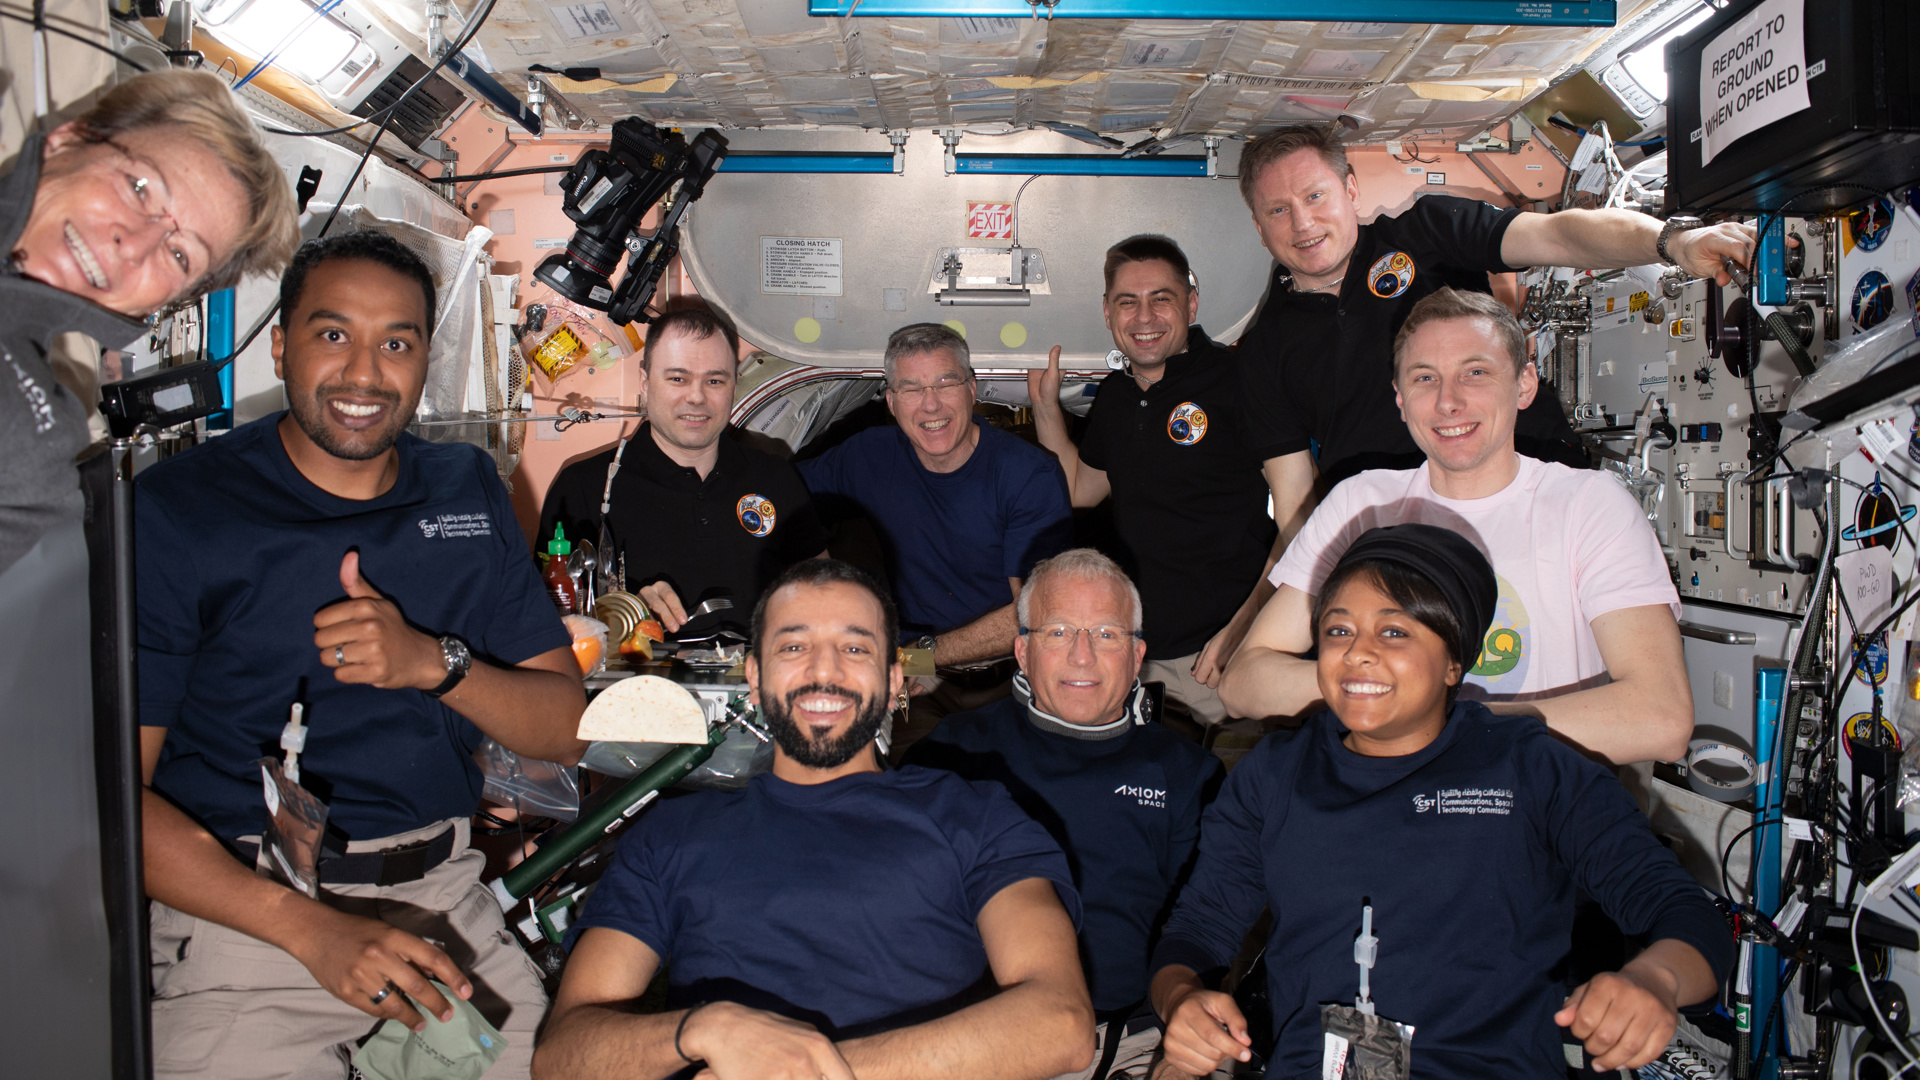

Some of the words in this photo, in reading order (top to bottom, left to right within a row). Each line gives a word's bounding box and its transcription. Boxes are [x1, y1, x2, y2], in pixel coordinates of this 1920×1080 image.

[1712, 28, 1762, 79] REPORT
[1766, 14, 1784, 40] TO
[1718, 49, 1774, 98] GROUND
[1705, 100, 1734, 138] WHEN
[1736, 64, 1800, 112] OPENED
[574, 175, 588, 196] Canon
[976, 212, 1005, 230] EXIT
[541, 336, 562, 354] WRNNG
[1114, 784, 1166, 800] AXIOM
[1441, 798, 1493, 806] Communications,
[1442, 806, 1476, 815] Technology
